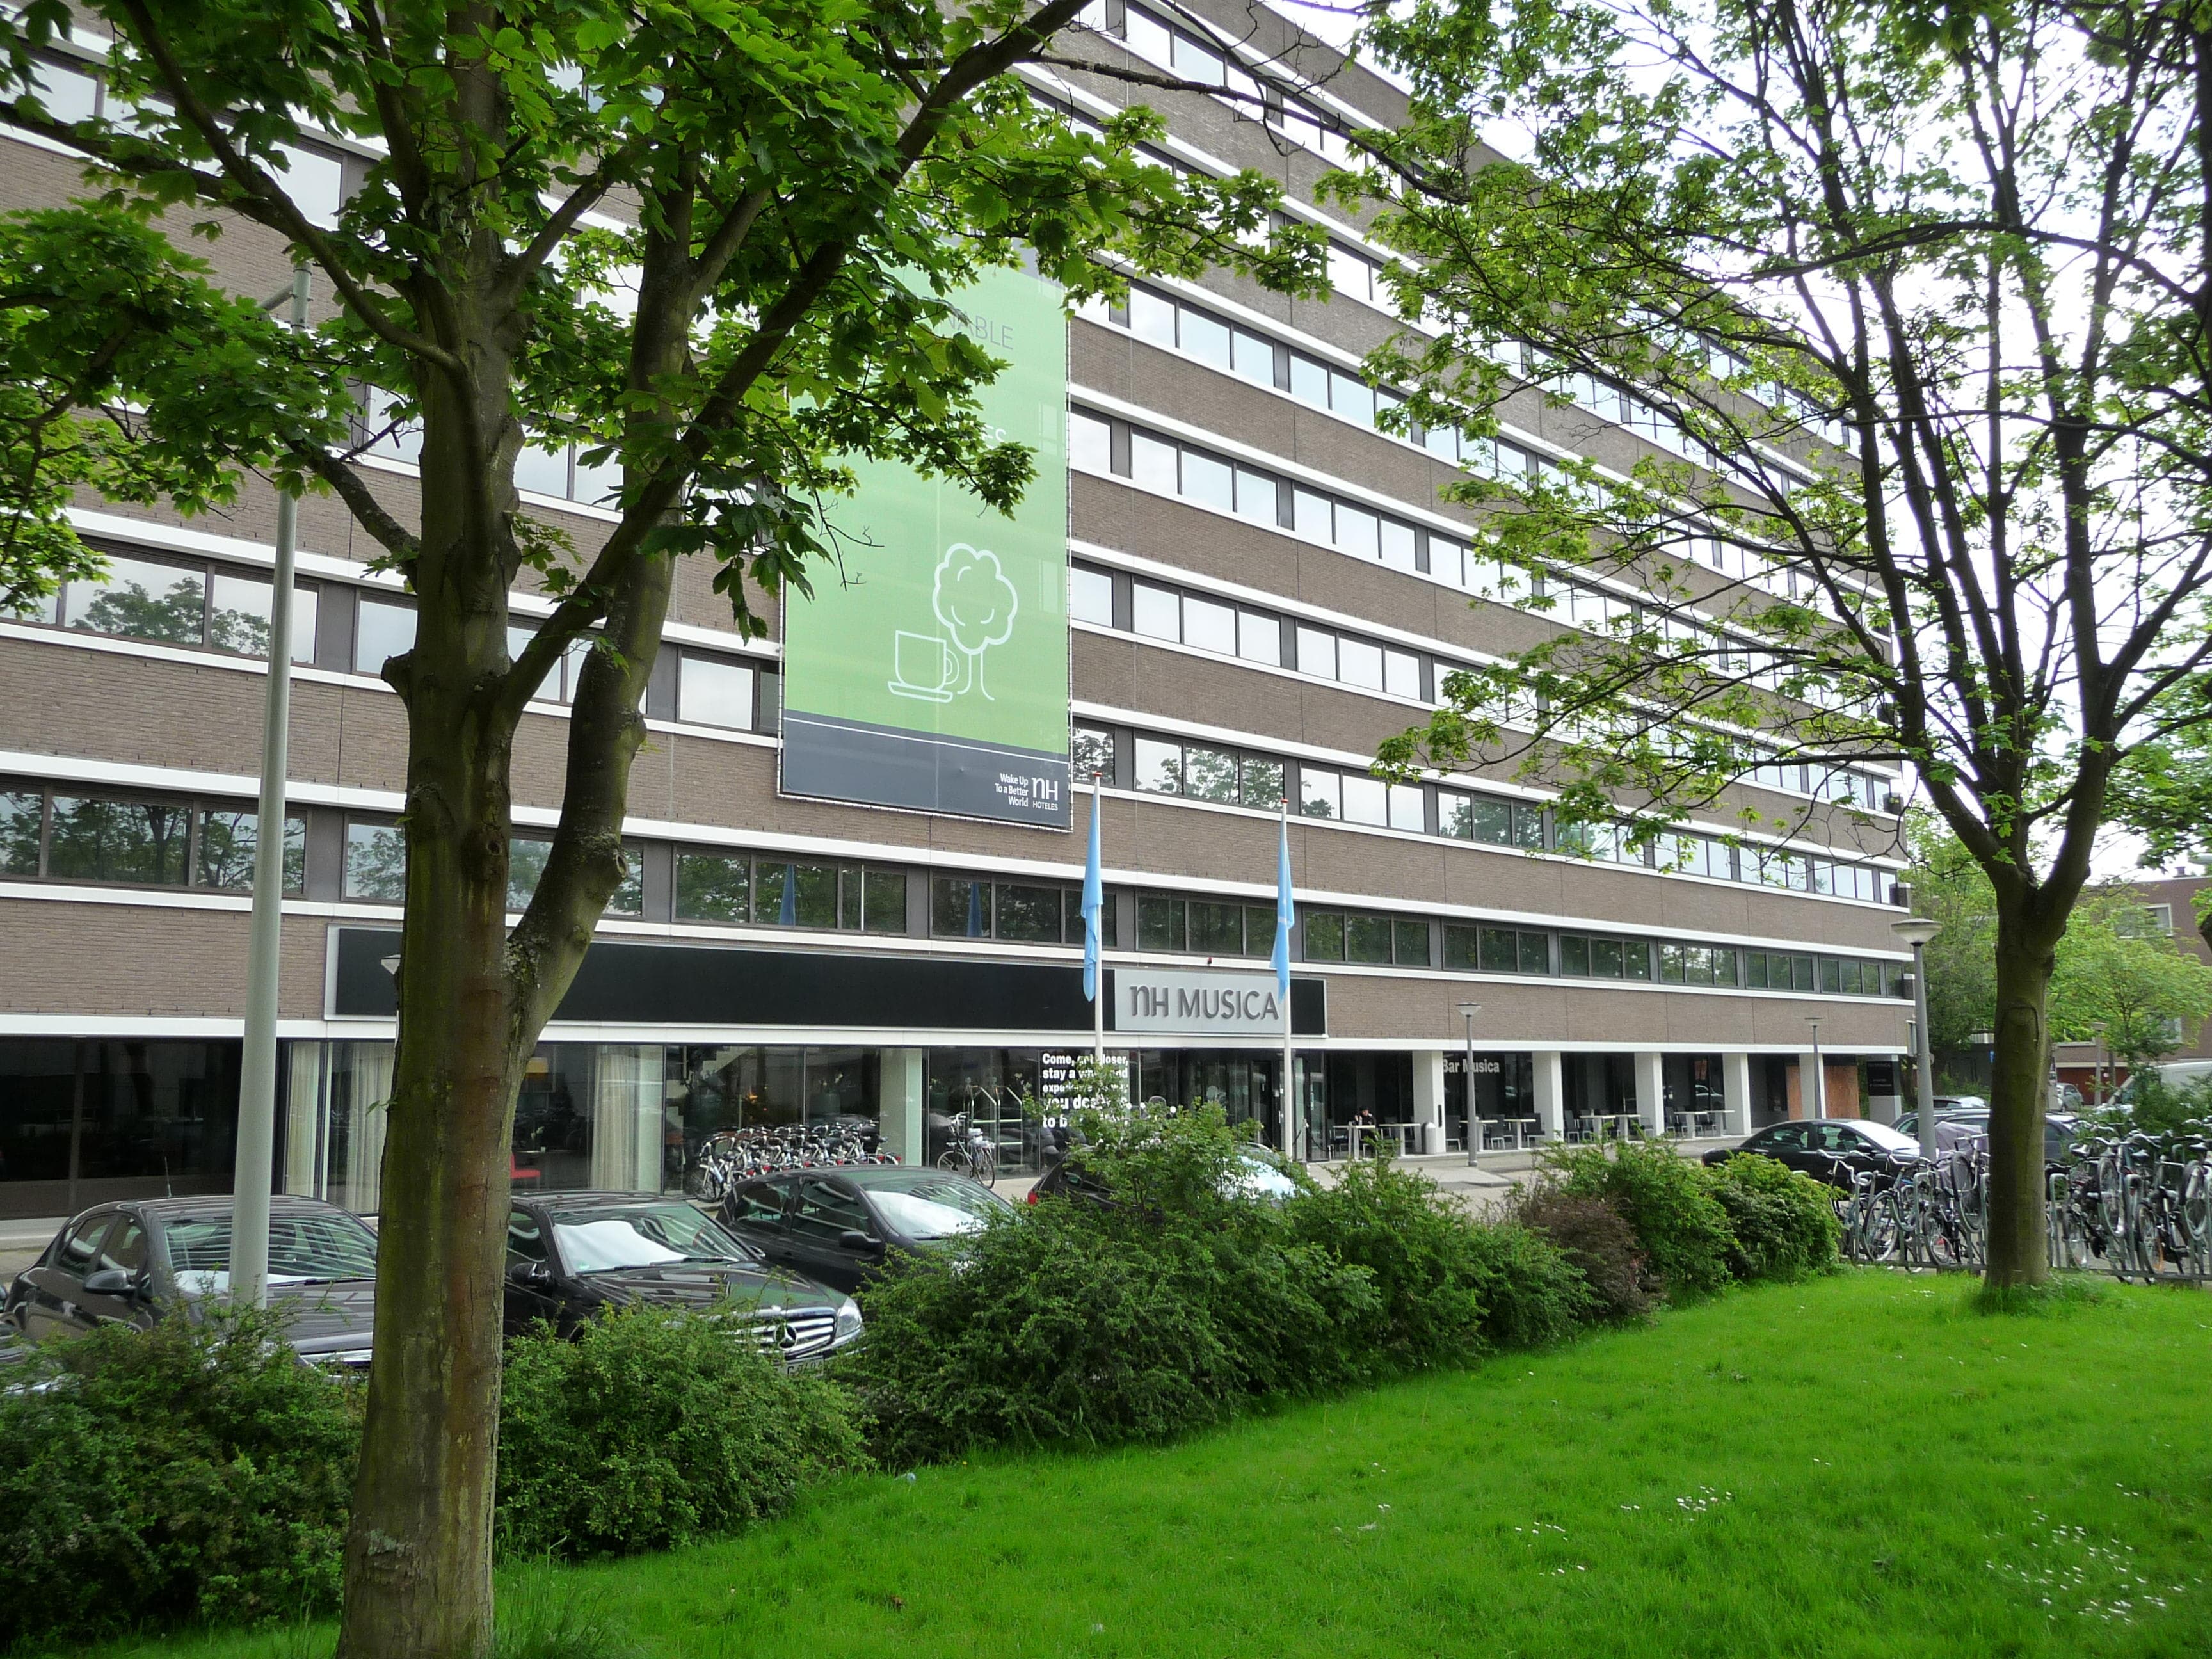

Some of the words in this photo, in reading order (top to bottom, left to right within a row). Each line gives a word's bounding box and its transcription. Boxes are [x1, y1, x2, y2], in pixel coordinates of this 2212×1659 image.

[1000, 773, 1018, 784] Wake
[1019, 776, 1029, 788] Up
[995, 783, 1003, 792] To
[1008, 785, 1029, 796] Better
[1008, 796, 1029, 807] World
[1032, 801, 1058, 811] HOTELES
[1178, 987, 1279, 1020] MUSICA
[1042, 1053, 1075, 1066] Come,
[1102, 1054, 1128, 1066] loser,
[1443, 1059, 1460, 1073] Bar
[1042, 1068, 1066, 1081] stay
[1068, 1070, 1076, 1079] a
[1042, 1114, 1056, 1128] to
